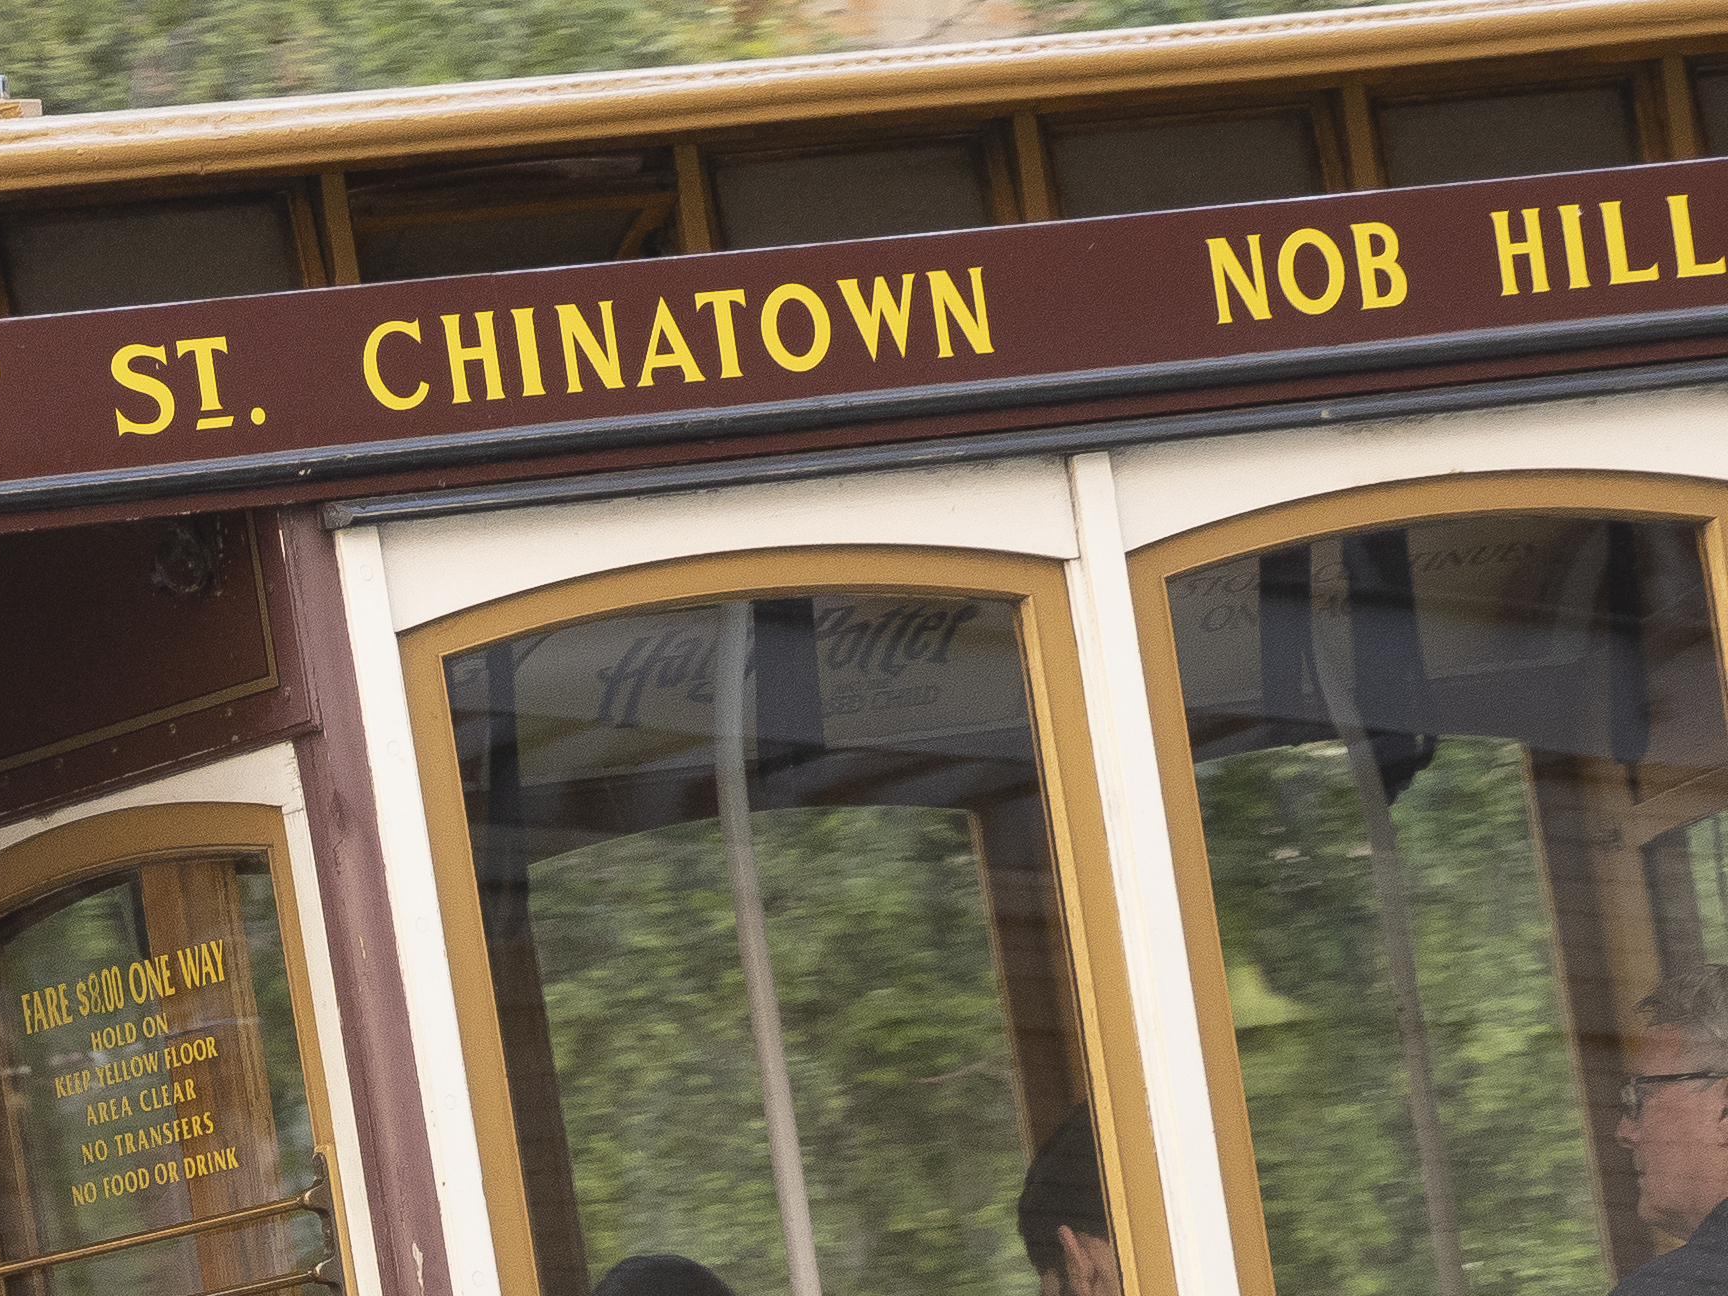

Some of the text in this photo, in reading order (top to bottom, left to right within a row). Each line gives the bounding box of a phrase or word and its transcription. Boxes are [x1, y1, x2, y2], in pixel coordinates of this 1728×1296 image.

[109, 335, 267, 437] ST.
[362, 265, 995, 412] CHINATOWN
[1205, 221, 1409, 326] NOB
[1490, 193, 1728, 297] HILL
[20, 982, 74, 1036] FARE
[128, 953, 176, 1005] ONE
[176, 938, 226, 990] WAY
[90, 1012, 169, 1052] HOLD ON
[54, 1036, 219, 1099] KEEP YELLOW FLOOR
[86, 1078, 197, 1127] AREA CLEAR
[80, 1111, 215, 1166] NO TRANSFERS
[70, 1146, 240, 1207] NO FOOD OR DRINK
